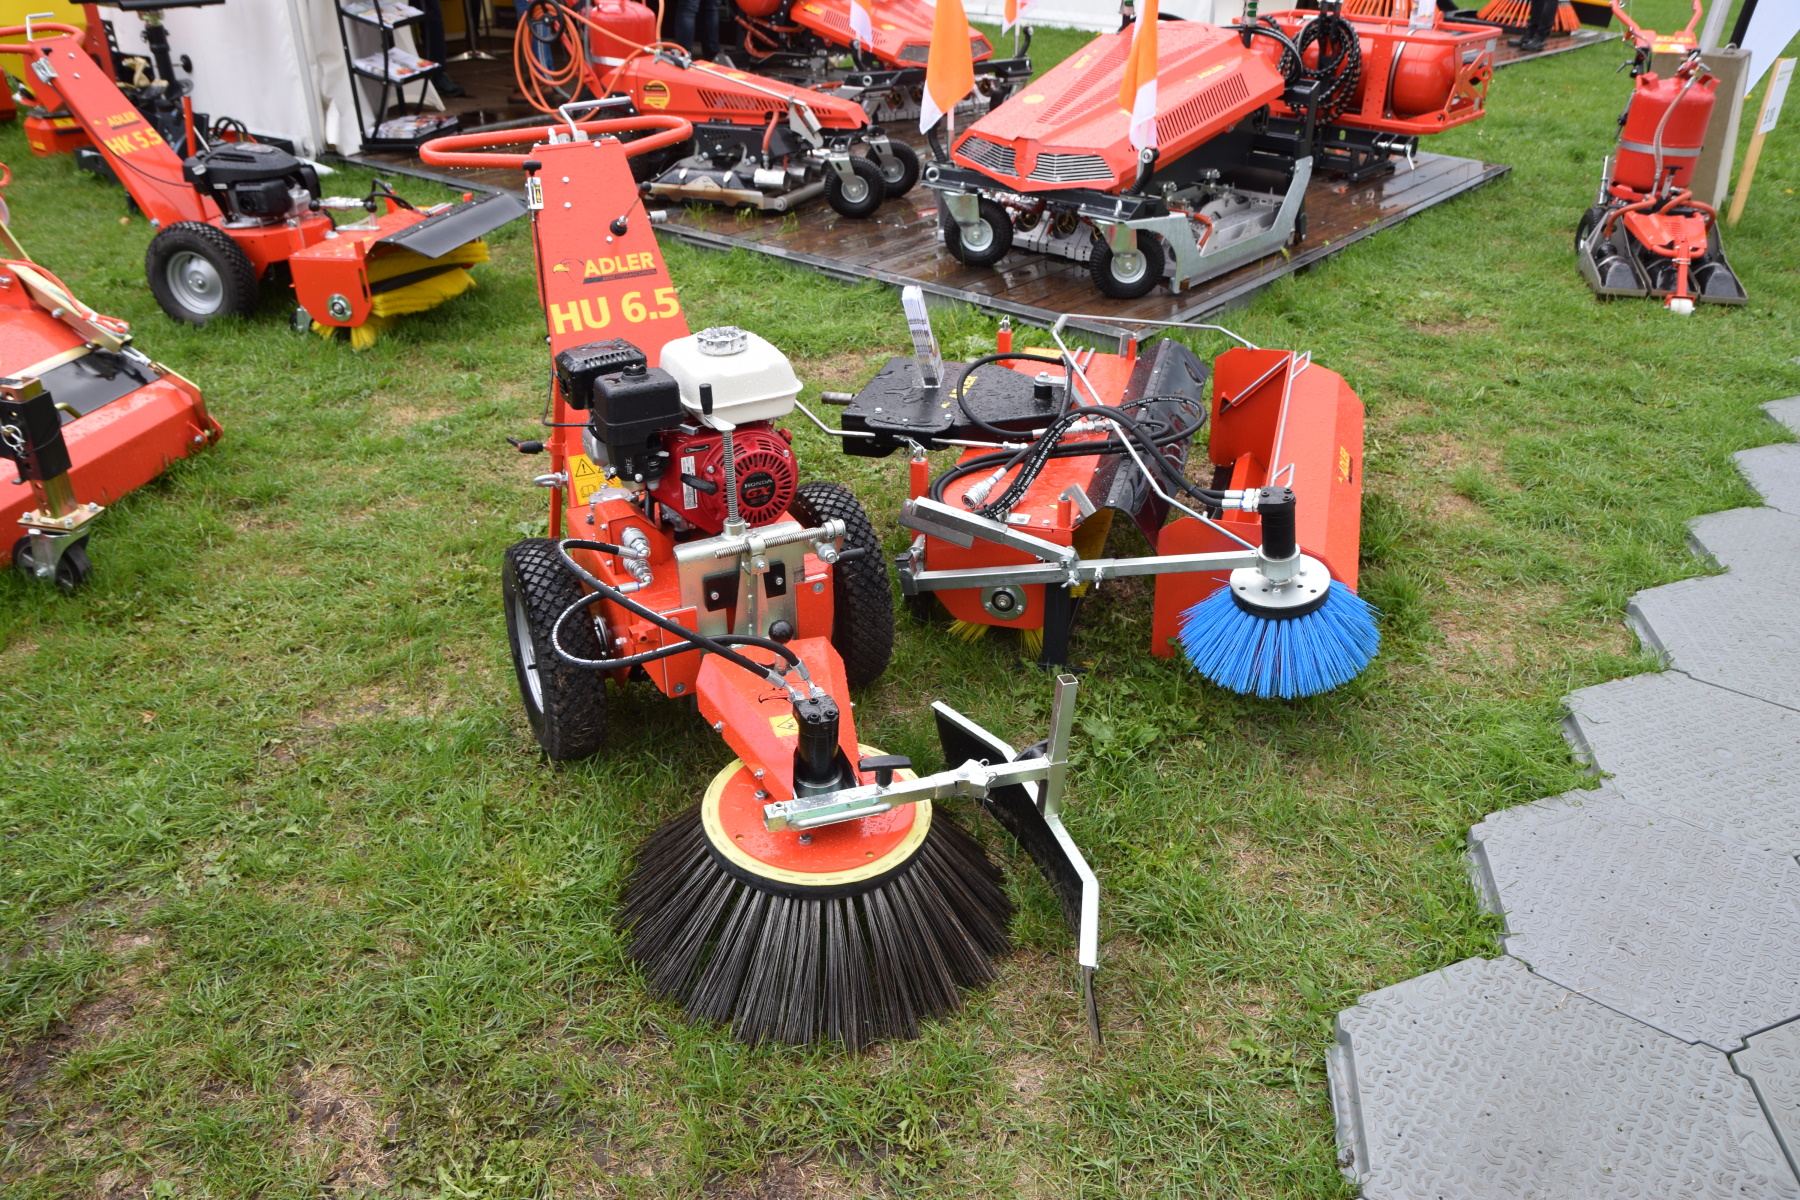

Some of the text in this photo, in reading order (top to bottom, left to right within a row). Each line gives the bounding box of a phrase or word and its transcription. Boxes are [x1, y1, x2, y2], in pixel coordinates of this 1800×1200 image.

[106, 111, 138, 127] ADLER
[103, 127, 163, 156] HK 5.5
[584, 252, 655, 277] ADLER
[550, 286, 680, 335] HU 6.5
[1338, 446, 1350, 480] ADLER
[744, 479, 772, 488] HONDA
[746, 485, 771, 498] GX
